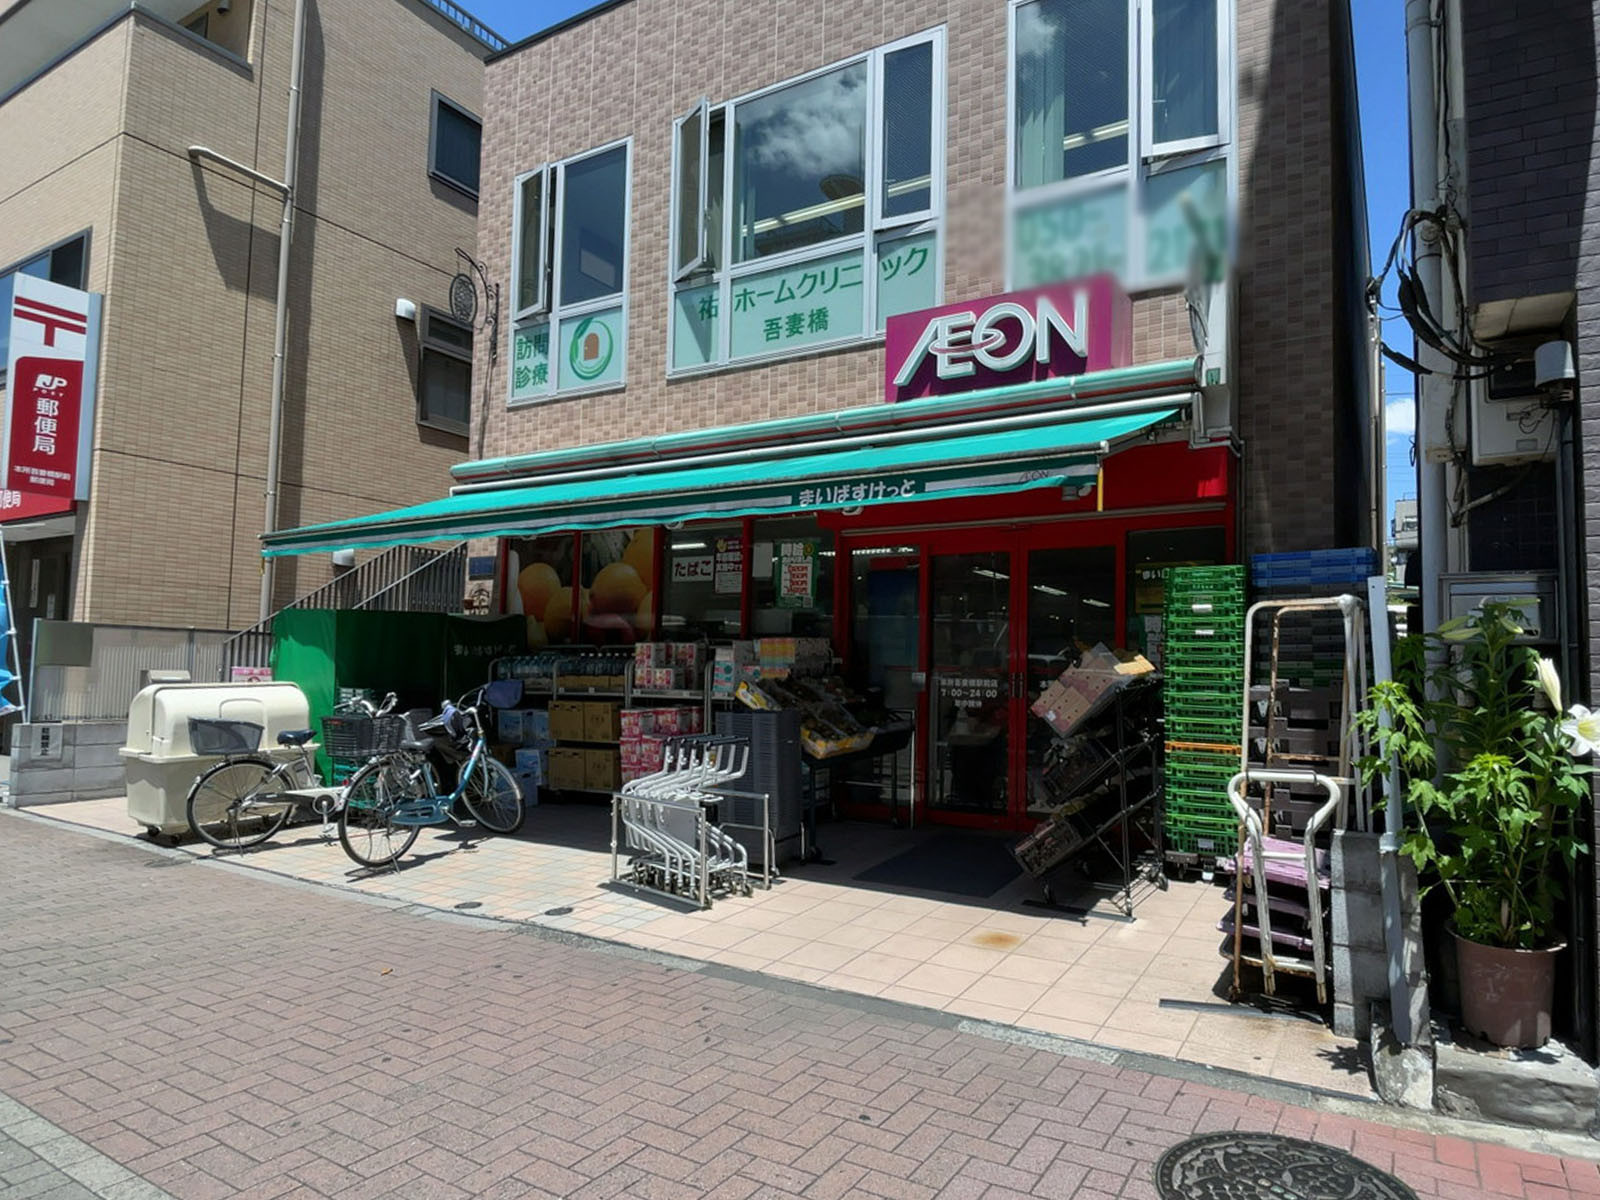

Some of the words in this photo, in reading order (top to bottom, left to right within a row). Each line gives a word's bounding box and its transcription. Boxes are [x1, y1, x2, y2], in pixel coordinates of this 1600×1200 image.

[763, 306, 830, 342] 吾妻橋
[516, 332, 548, 361] 訪問
[515, 363, 548, 389] 診療
[32, 397, 59, 455] 郵便局
[799, 479, 915, 507] まいばすけっと
[674, 560, 712, 577] たばこ
